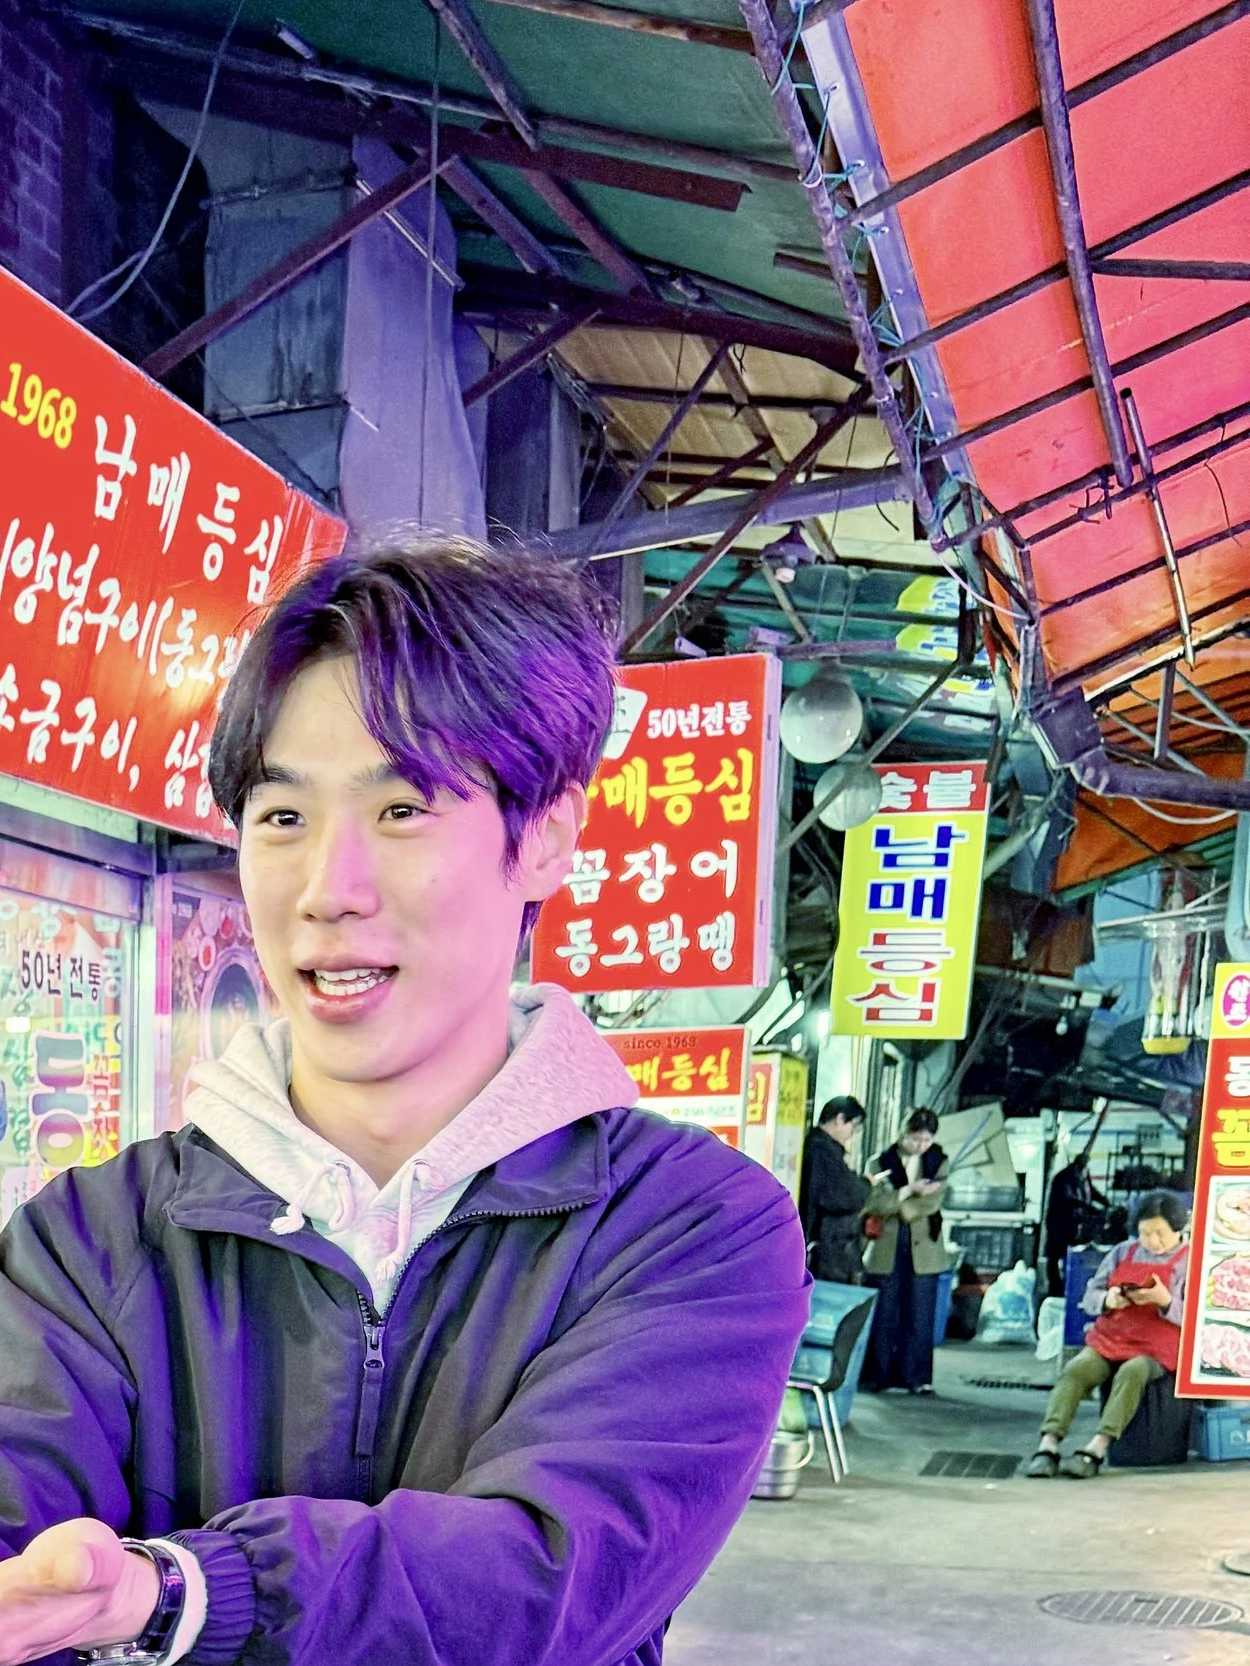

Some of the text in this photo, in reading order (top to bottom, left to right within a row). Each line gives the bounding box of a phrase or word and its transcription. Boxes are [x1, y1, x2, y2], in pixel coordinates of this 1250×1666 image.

[0, 362, 77, 449] 1968
[586, 748, 754, 829] 매등심
[562, 839, 738, 906] 꼼장어
[555, 910, 737, 977] 동그랑땡
[848, 823, 968, 1023] 남매등심
